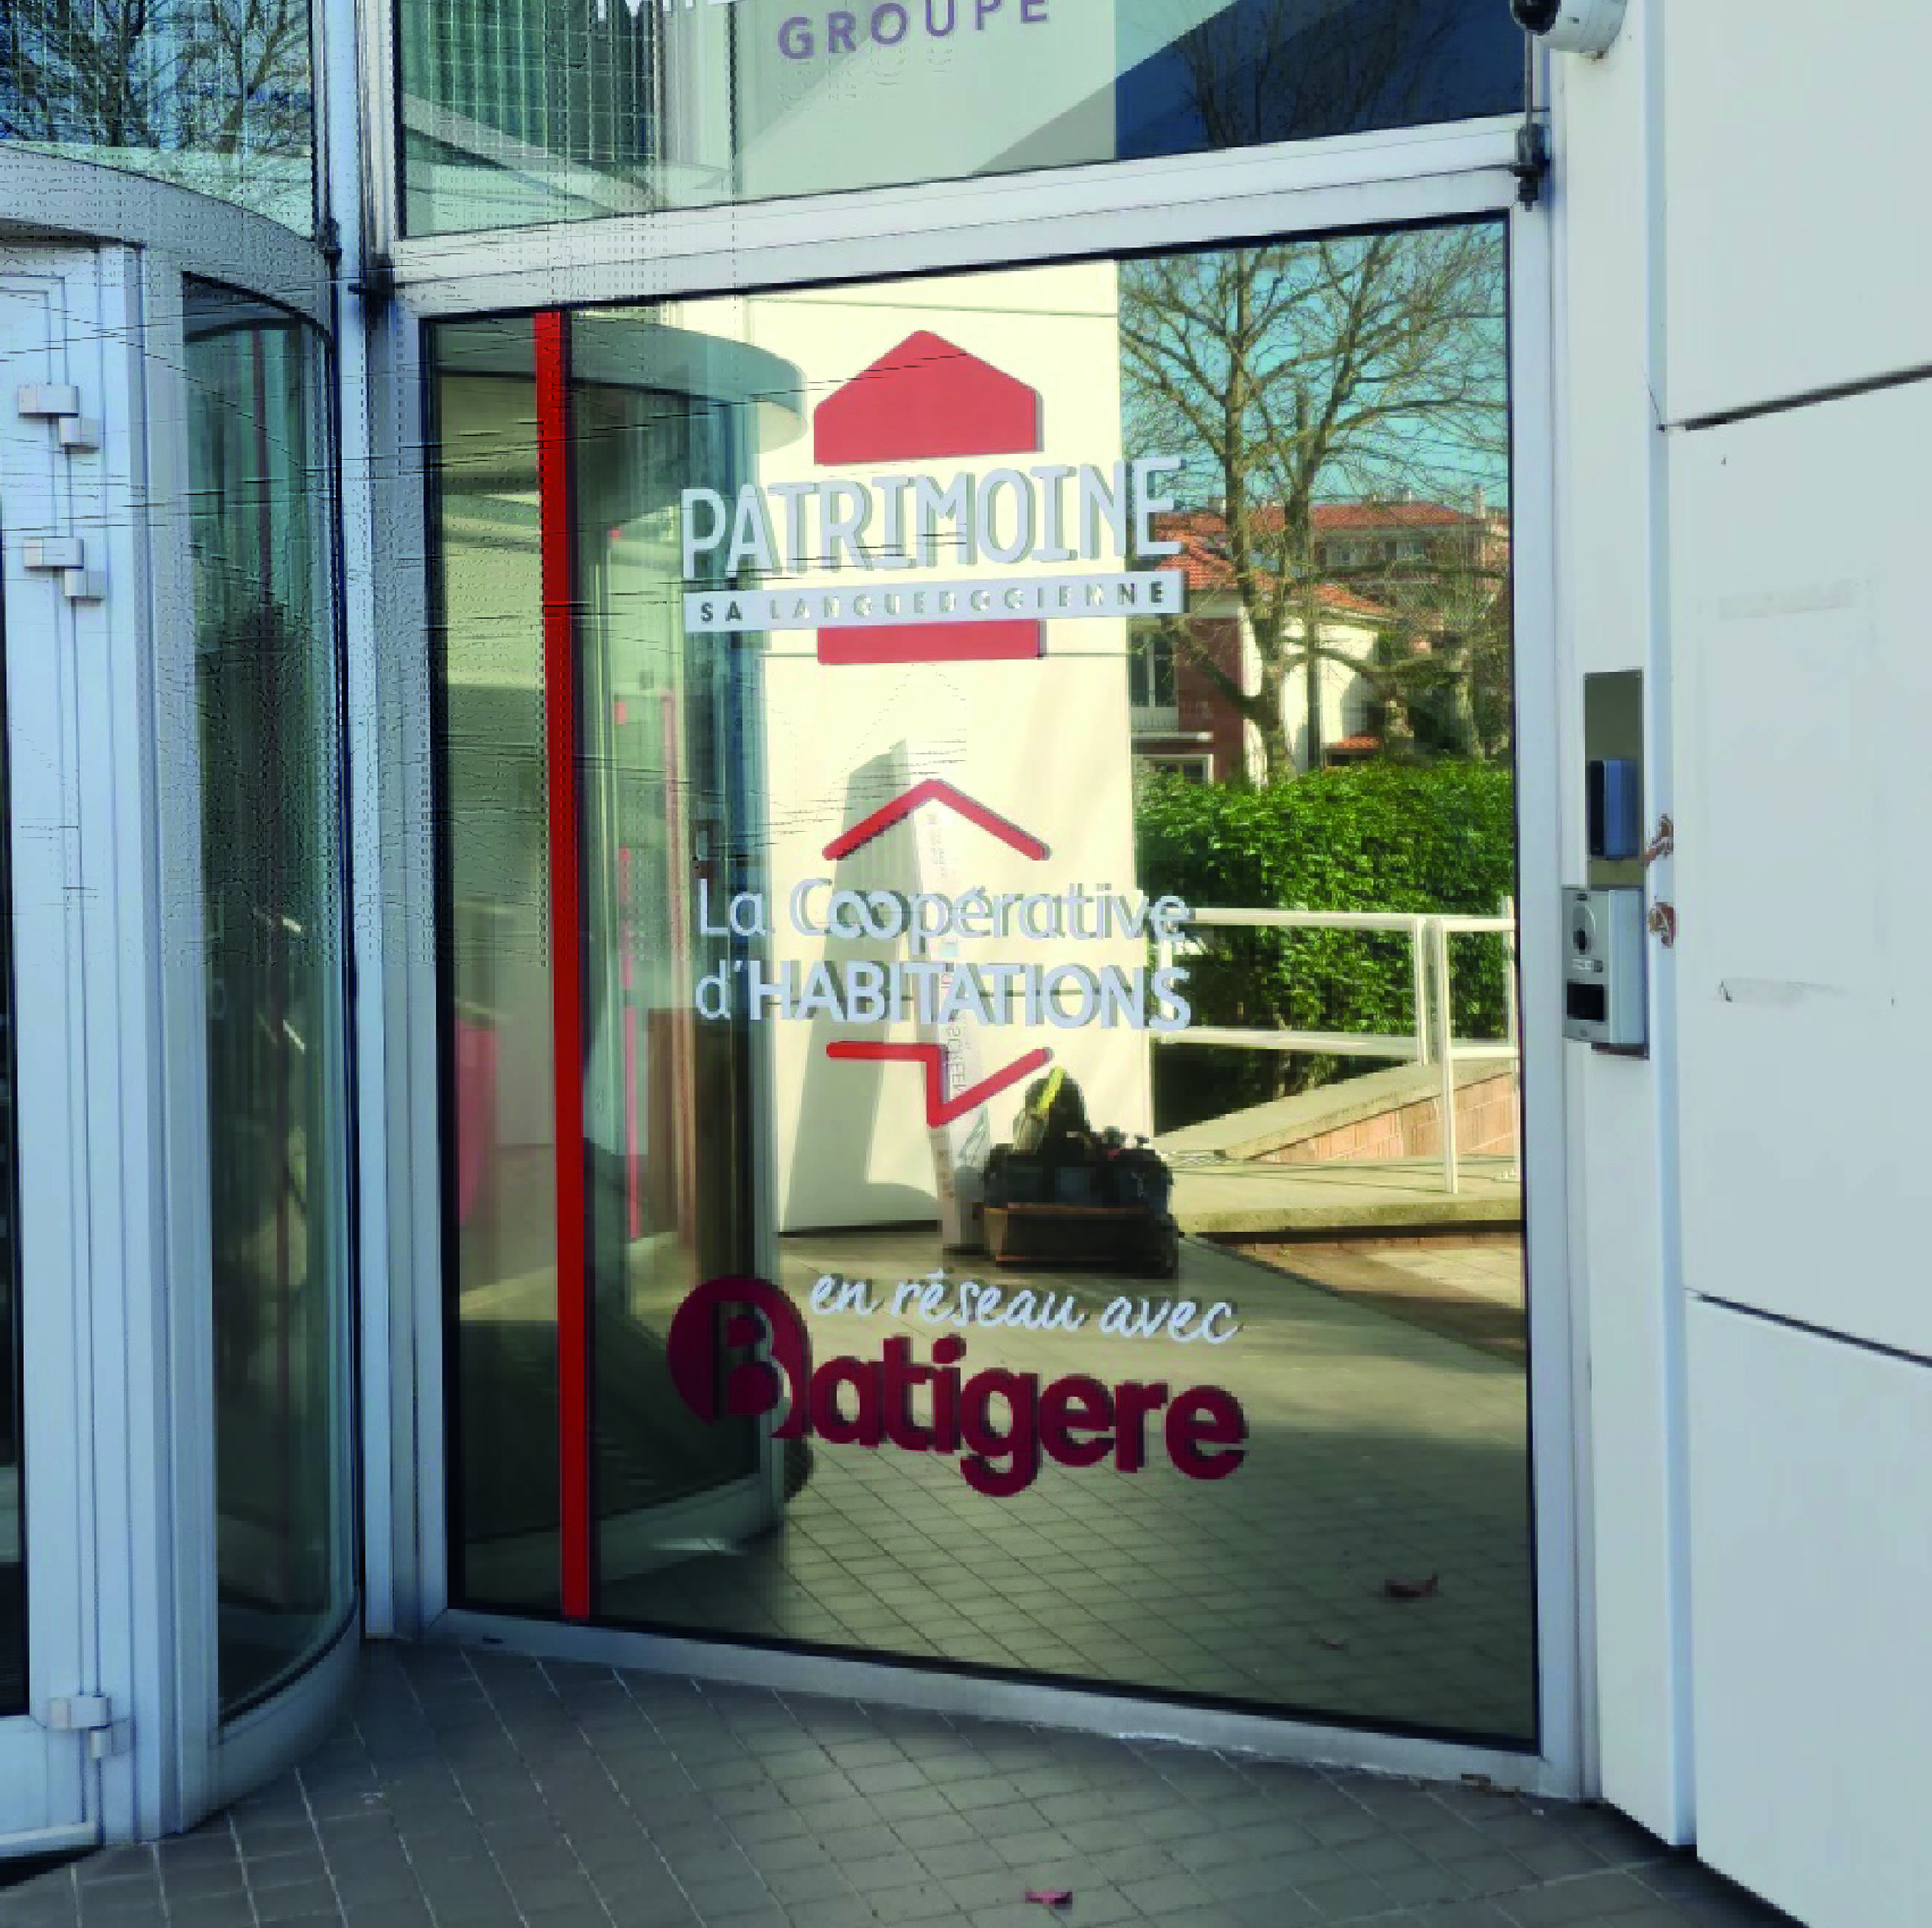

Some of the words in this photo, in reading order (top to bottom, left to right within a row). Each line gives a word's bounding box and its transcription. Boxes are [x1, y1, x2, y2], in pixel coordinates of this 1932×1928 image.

[777, 0, 1049, 59] GROUPE
[681, 455, 1182, 581] PATRIMOINE
[700, 600, 742, 623] SA
[699, 879, 767, 937] La
[695, 959, 1192, 1031] d'HABITATIONS
[809, 1273, 880, 1317] en
[891, 1270, 1084, 1332] réseau
[1101, 1295, 1240, 1344] avec
[667, 1275, 1248, 1496] Batigere
